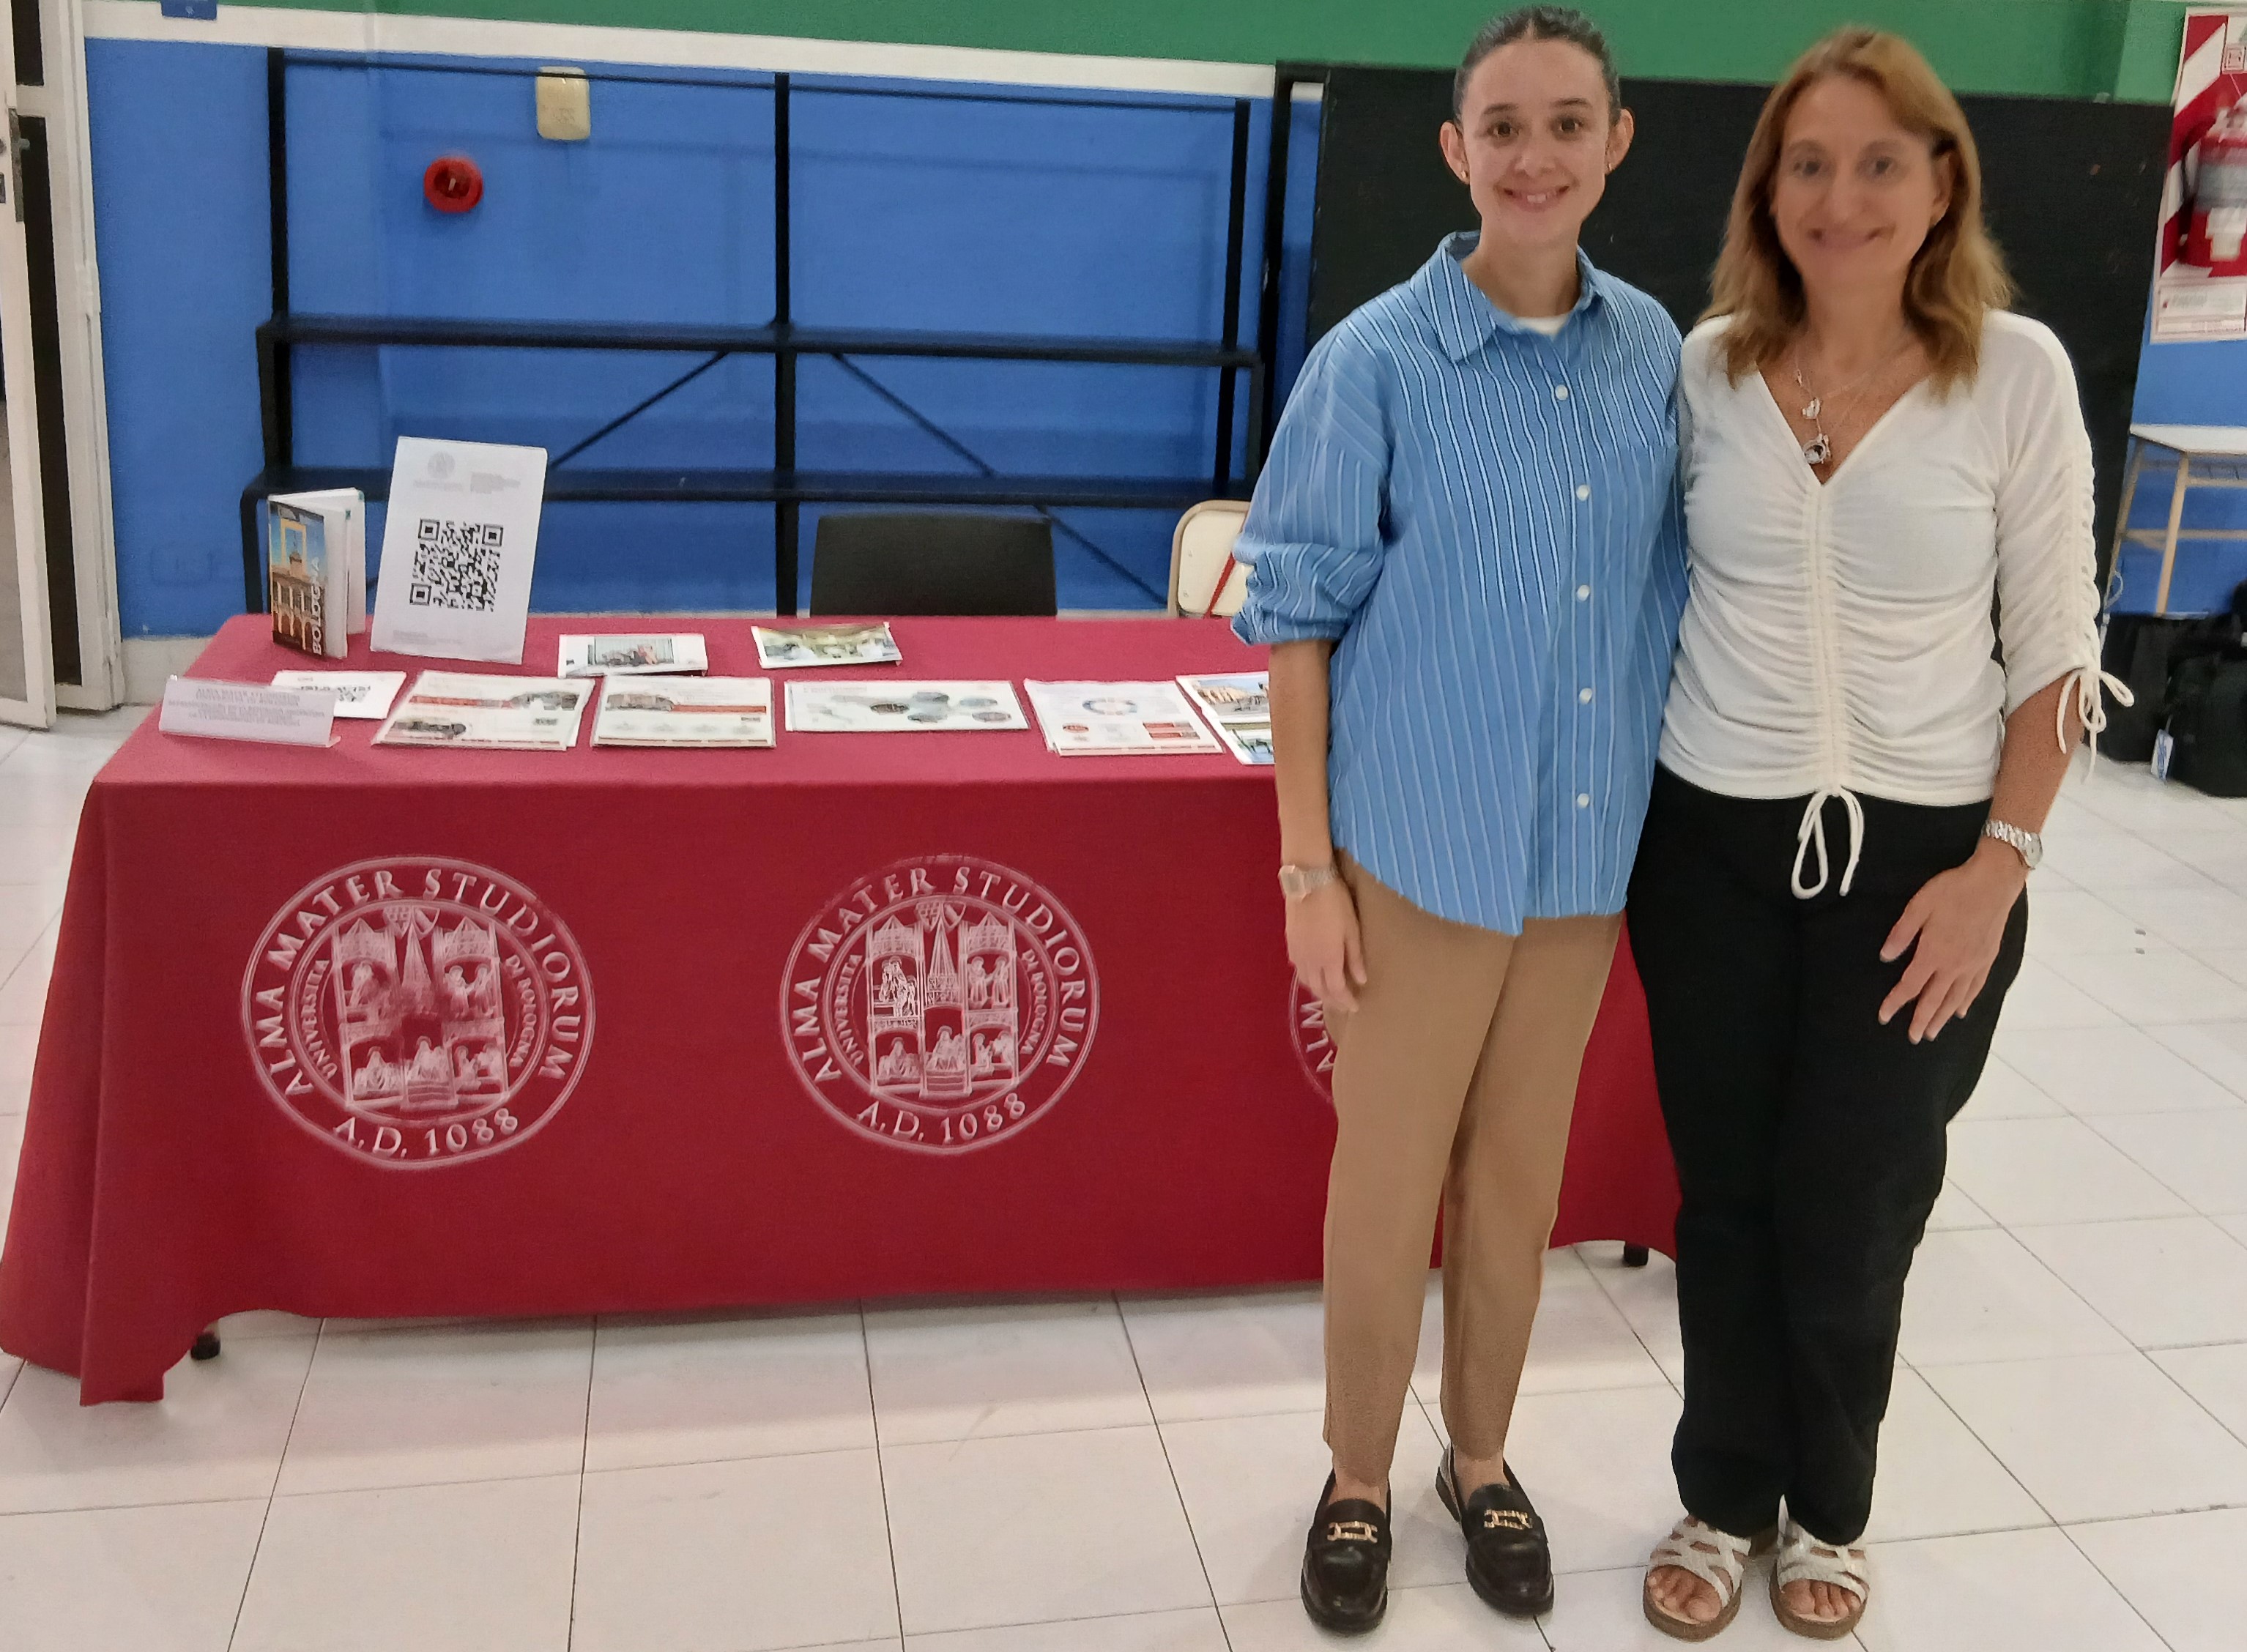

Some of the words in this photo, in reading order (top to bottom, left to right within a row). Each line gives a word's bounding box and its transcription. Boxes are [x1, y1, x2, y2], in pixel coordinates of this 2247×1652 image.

[267, 869, 404, 972] MATER
[808, 867, 937, 963] MATER
[423, 868, 581, 1080] STUDIORUM
[954, 866, 1087, 1068] STUDIORUM
[256, 985, 313, 1096] ALMA
[792, 976, 842, 1083] ALMA
[1300, 1000, 1335, 1073] ALM
[333, 1116, 407, 1158] A.D.
[425, 1107, 519, 1156] 1088
[855, 1101, 924, 1142] A.D.
[940, 1093, 1025, 1145] 1088
